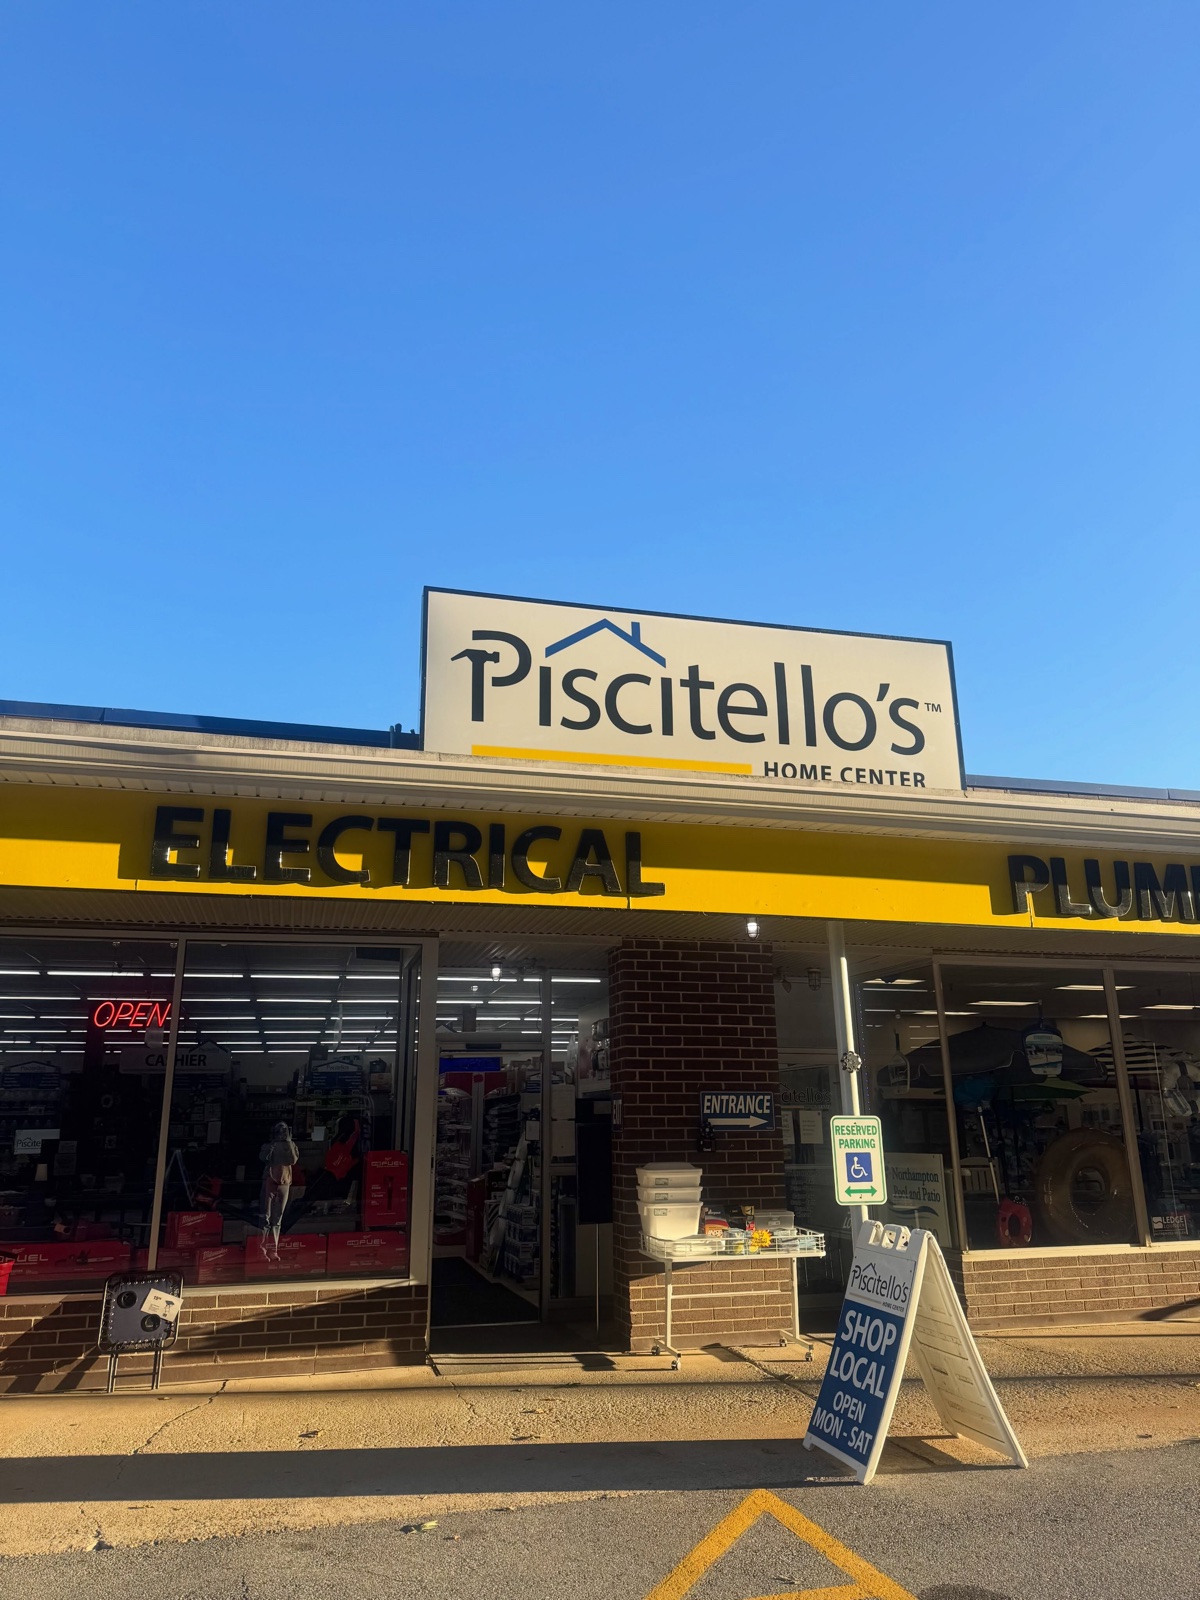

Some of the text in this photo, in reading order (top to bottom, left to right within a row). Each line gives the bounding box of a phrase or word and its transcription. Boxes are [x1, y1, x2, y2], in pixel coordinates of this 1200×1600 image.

[451, 630, 925, 756] Piscitello's
[764, 761, 926, 788] HOME CENTER
[151, 805, 666, 896] ELECTRICAL
[93, 1001, 171, 1028] OPEN
[145, 1053, 207, 1067] CAHIER
[703, 1095, 770, 1114] ENTRANCE
[835, 1125, 877, 1136] RESERVED
[838, 1138, 876, 1149] PARKING
[891, 1167, 939, 1186] Northampton
[909, 1187, 921, 1201] and
[922, 1187, 941, 1203] Patio
[1162, 1215, 1184, 1224] LEDGE
[851, 1265, 909, 1303] Piscitello's
[840, 1310, 897, 1356] SHOP
[829, 1351, 885, 1399] LOCAL
[833, 1391, 867, 1424] OPEN
[813, 1409, 842, 1439] MON
[847, 1426, 873, 1455] SAT
